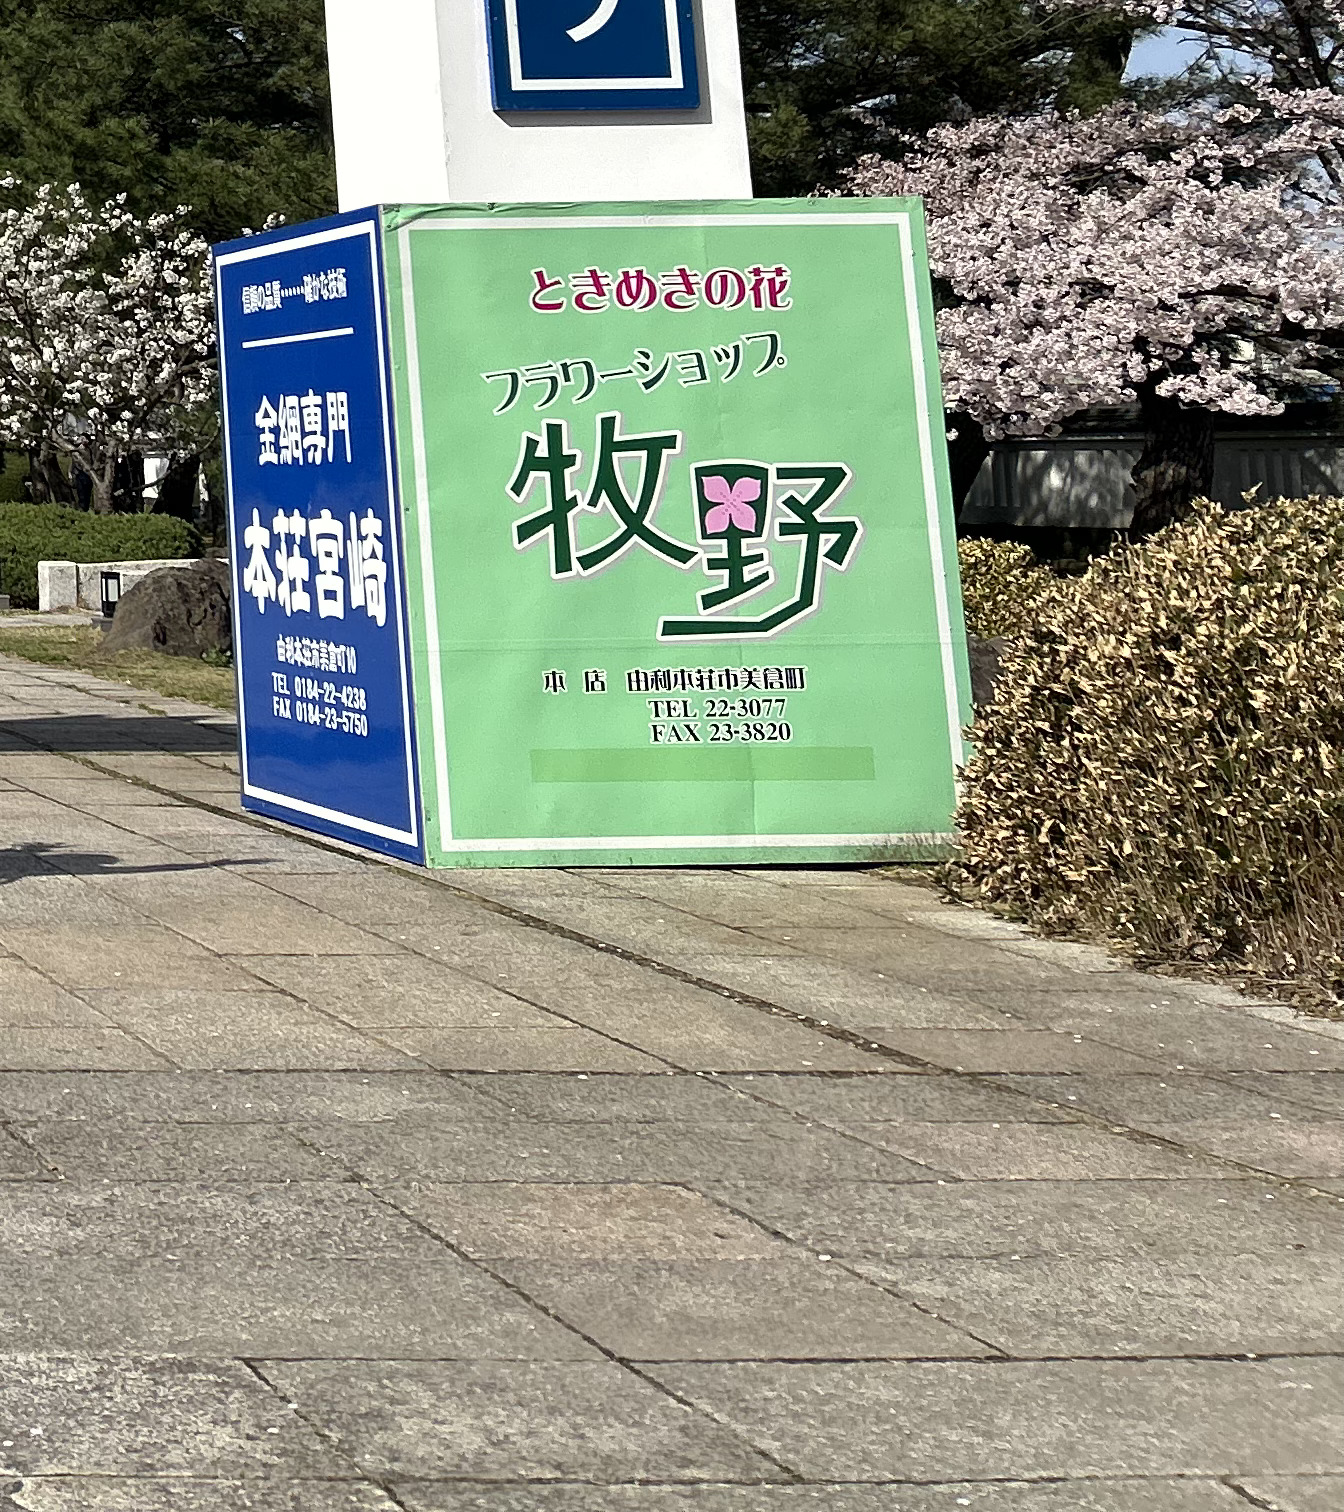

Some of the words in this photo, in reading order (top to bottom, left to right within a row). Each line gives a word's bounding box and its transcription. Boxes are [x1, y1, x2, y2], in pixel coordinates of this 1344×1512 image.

[529, 266, 793, 312] ときめきの花
[484, 331, 787, 414] フラワーショップ
[255, 389, 352, 467] 金網専門
[509, 414, 861, 639] 牧野
[243, 507, 388, 626] 本荘宮崎
[272, 672, 291, 695] TEL
[294, 676, 367, 711] 0184-22-4238
[627, 667, 807, 691] 由利本荘市美倉町
[273, 696, 292, 720] FAX
[295, 700, 368, 737] 0184-23-5750
[647, 699, 697, 719] TEL
[704, 698, 787, 718] 22-3077
[651, 723, 702, 743] FAX
[709, 722, 792, 742] 23-3820
